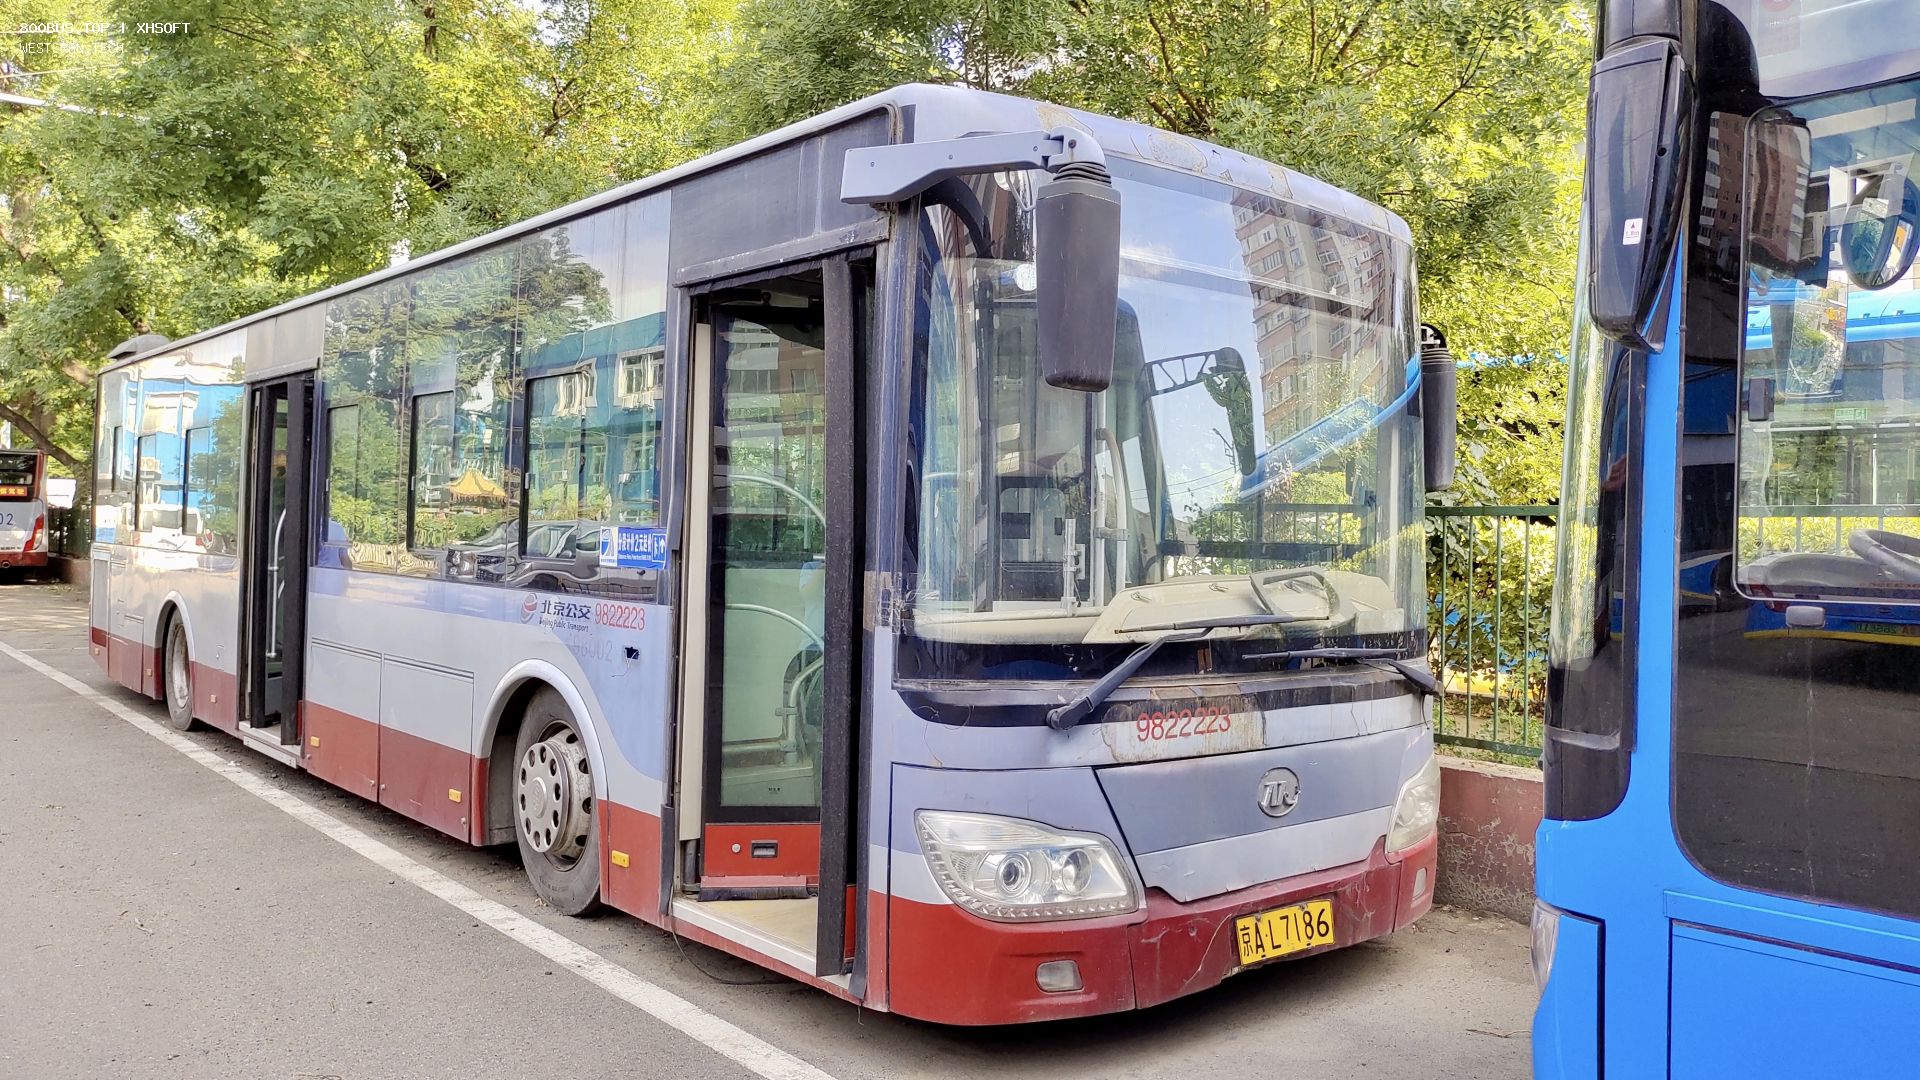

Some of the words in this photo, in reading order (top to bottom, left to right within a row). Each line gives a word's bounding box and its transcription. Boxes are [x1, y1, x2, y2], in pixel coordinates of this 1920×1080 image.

[540, 600, 592, 620] 北京公交
[594, 602, 646, 631] 9822223
[566, 621, 590, 633] Transport
[1136, 705, 1232, 743] 9822223
